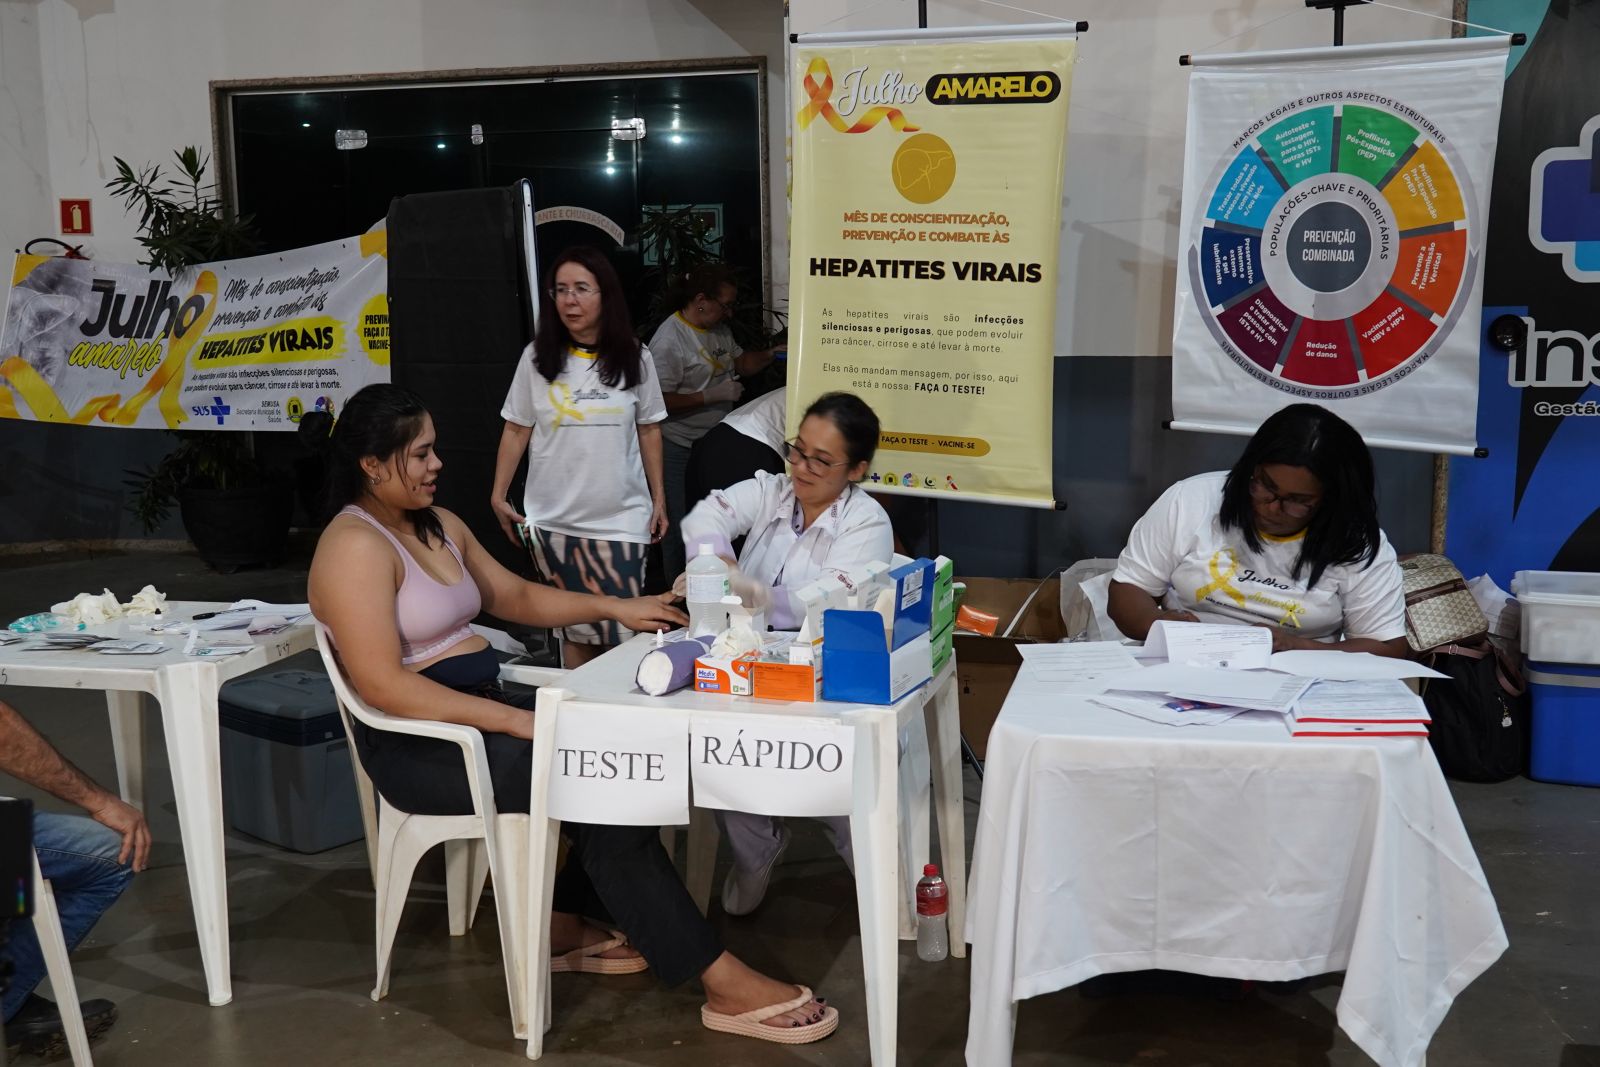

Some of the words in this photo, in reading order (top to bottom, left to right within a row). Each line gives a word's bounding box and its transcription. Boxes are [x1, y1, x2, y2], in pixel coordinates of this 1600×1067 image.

[838, 65, 924, 116] Julho
[933, 75, 1053, 99] AMARELO
[1233, 119, 1265, 149] MARCOS
[1265, 101, 1297, 122] LEGAIS
[1306, 91, 1343, 104] OUTROS
[1346, 91, 1392, 107] ASPECTOS
[1393, 101, 1447, 144] ESTRUTURAIS
[1275, 122, 1309, 141] Autoteste
[1281, 130, 1314, 147] testagem
[1357, 128, 1391, 146] Profilaxia
[1280, 147, 1297, 157] para
[1282, 152, 1306, 164] outras
[1305, 145, 1321, 156] ISTs
[1345, 134, 1396, 158] Pós-Exposição
[1356, 149, 1377, 161] (PEP)
[1301, 157, 1312, 166] HV
[1217, 191, 1233, 212] Tratar
[1230, 172, 1245, 191] todas
[1242, 163, 1250, 172] as
[1418, 163, 1438, 198] Profilaxia
[1223, 192, 1242, 220] pessoas
[1239, 164, 1258, 192] vivendo
[1238, 195, 1249, 210] com
[1246, 181, 1256, 196] HIV
[843, 210, 869, 223] MÊS
[870, 212, 888, 223] DE
[889, 212, 1010, 227] CONSCIENTIZAÇÃO,
[1269, 183, 1346, 257] POPULAÇÕES-CHAVE
[1347, 185, 1355, 195] E
[1356, 190, 1391, 260] PRIORITÁRIAS
[842, 229, 916, 243] PREVENÇÃO
[918, 231, 926, 241] E
[928, 231, 990, 242] COMBATE
[992, 231, 1010, 243] ÀS
[1303, 228, 1356, 245] PREVENÇÃO
[1213, 242, 1222, 285] lubrificante
[1229, 249, 1237, 278] externo
[1243, 237, 1254, 285] Preservativo
[1302, 248, 1355, 262] COMBINADA
[1418, 242, 1436, 290] Transmissão
[809, 257, 946, 280] HEPATITES
[952, 261, 1042, 283] VIRAIS
[1222, 261, 1230, 274] gel
[1411, 253, 1426, 286] Prevenir
[1429, 252, 1443, 284] Vertical
[224, 278, 250, 303] Mês
[250, 277, 264, 299] de
[265, 266, 340, 295] conscientização,
[79, 278, 206, 339] Julho
[208, 306, 262, 332] prevenção
[263, 306, 273, 321] e
[365, 314, 390, 325] PREVIN
[822, 308, 833, 317] As
[846, 309, 889, 319] hepatites
[903, 311, 929, 320] virais
[943, 313, 960, 322] são
[974, 314, 1024, 326] infecções
[1254, 298, 1289, 333] Diagnosticar
[821, 322, 873, 333] silenciosas
[884, 325, 934, 336] perigosas,
[937, 329, 954, 337] que
[956, 328, 987, 338] podem
[990, 330, 1024, 339] evoluir
[1238, 317, 1251, 331] ISTs
[1254, 332, 1265, 343] HV
[1243, 311, 1266, 334] pessoas
[1264, 331, 1278, 346] com
[1253, 309, 1270, 326] tratar
[1268, 324, 1277, 334] as
[1362, 318, 1387, 339] Vacinas
[1387, 306, 1403, 322] para
[1370, 330, 1385, 344] HBV
[1390, 314, 1406, 329] HPV
[199, 332, 268, 360] HEPATITES
[269, 326, 334, 353] VIRAIS
[363, 327, 380, 339] FAÇA
[380, 327, 385, 337] O
[68, 331, 166, 380] amarelo
[821, 337, 840, 345] para
[842, 336, 875, 347] câncer,
[877, 338, 909, 348] cirrose
[920, 341, 936, 350] até
[938, 341, 962, 351] levar
[964, 341, 970, 351] à
[972, 344, 1003, 353] morte.
[1306, 341, 1337, 350] Redução
[1316, 351, 1338, 359] danos
[1512, 323, 1600, 384] In
[228, 370, 238, 379] são
[238, 368, 270, 379] infecções
[270, 367, 303, 377] silenciosas
[307, 367, 339, 378] perigosas,
[823, 362, 841, 372] Elas
[843, 364, 859, 373] não
[861, 366, 898, 376] mandam
[900, 369, 952, 379] mensagem,
[955, 372, 970, 380] por
[973, 372, 996, 382] isso,
[998, 374, 1019, 384] aqui
[1221, 341, 1268, 383] ESTRUTURAIS
[1394, 352, 1430, 380] MARCOS
[208, 382, 228, 391] evoluir
[228, 383, 244, 392] para
[244, 381, 268, 391] câncer,
[268, 380, 287, 389] cirrose
[291, 379, 299, 389] até
[299, 380, 314, 389] levar
[315, 379, 320, 389] à
[320, 380, 342, 389] morte.
[852, 379, 872, 388] está
[882, 382, 912, 391] nossa:
[914, 382, 939, 394] FAÇA
[942, 384, 950, 392] O
[952, 384, 985, 395] TESTE!
[1269, 379, 1313, 397] ASPECTOS
[1315, 390, 1351, 399] OUTROS
[1362, 376, 1393, 394] LEGAIS
[192, 405, 211, 416] SUS
[236, 408, 257, 416] Secretaria
[261, 400, 280, 408] SEMUSA
[1536, 402, 1600, 416] Gestã
[267, 415, 282, 423] Saúde
[881, 435, 900, 444] FAÇA
[909, 437, 928, 445] TESTE
[938, 440, 976, 449] VACINE-SE
[1238, 569, 1293, 591] Julho
[701, 728, 843, 773] RÁPIDO
[558, 747, 666, 783] TESTE
